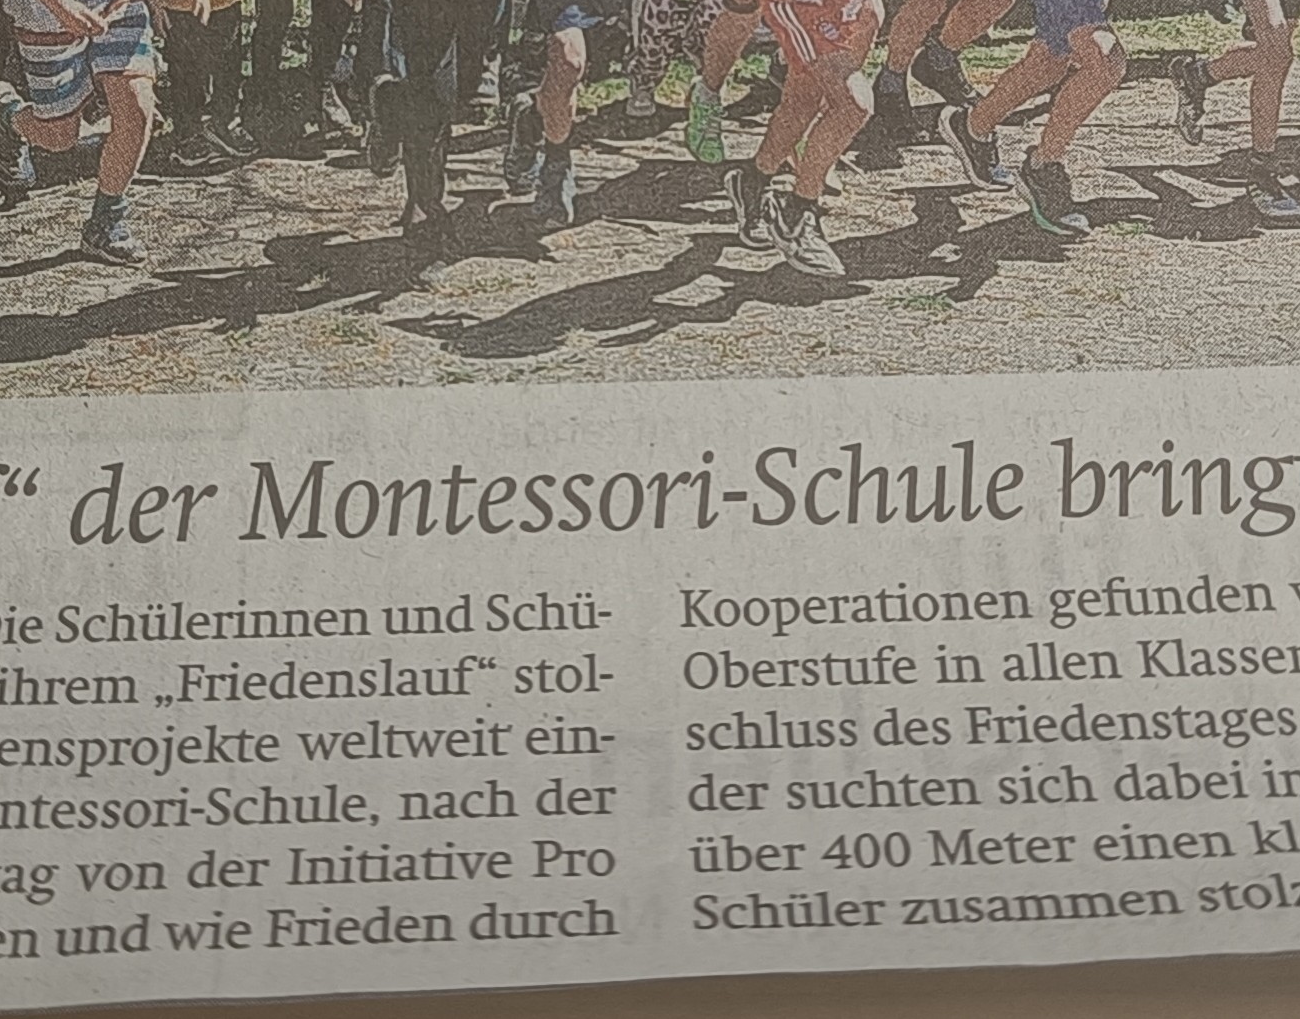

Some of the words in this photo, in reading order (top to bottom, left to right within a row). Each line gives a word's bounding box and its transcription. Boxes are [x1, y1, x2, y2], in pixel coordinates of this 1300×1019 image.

[70, 462, 218, 545] der
[239, 440, 1023, 540] Montessori-Schule
[56, 600, 370, 643] Schülerinnen
[382, 594, 474, 635] und
[487, 592, 611, 632] Schü-
[680, 583, 1033, 637] Kooperationen
[1050, 574, 1276, 629] gefunden
[155, 655, 496, 707] „Friedenslauf“
[515, 654, 613, 693] stol-
[684, 645, 917, 689] Oberstufe
[935, 645, 985, 683] in
[1004, 642, 1122, 681] allen
[298, 718, 512, 760] weltweit
[526, 716, 615, 755] ein-
[687, 711, 857, 750] schluss
[874, 708, 951, 746] des
[965, 703, 1297, 748] Friedenstages
[399, 780, 518, 820] nach
[536, 778, 616, 816] der
[688, 773, 769, 811] der
[787, 770, 981, 810] suchten
[999, 765, 1097, 804] sich
[1114, 760, 1248, 801] dabei
[77, 862, 166, 891] von
[187, 850, 269, 888] der
[287, 842, 512, 885] Initiative
[533, 840, 615, 877] Pro
[690, 835, 805, 873] über
[822, 832, 911, 869] 400
[928, 829, 1075, 866] Meter
[1094, 824, 1235, 861] einen
[55, 914, 150, 956] und
[164, 911, 251, 950] wie
[266, 906, 455, 947] Frieden
[469, 899, 619, 940] durch
[694, 892, 886, 930] Schüler
[901, 890, 1183, 925] zusammen
